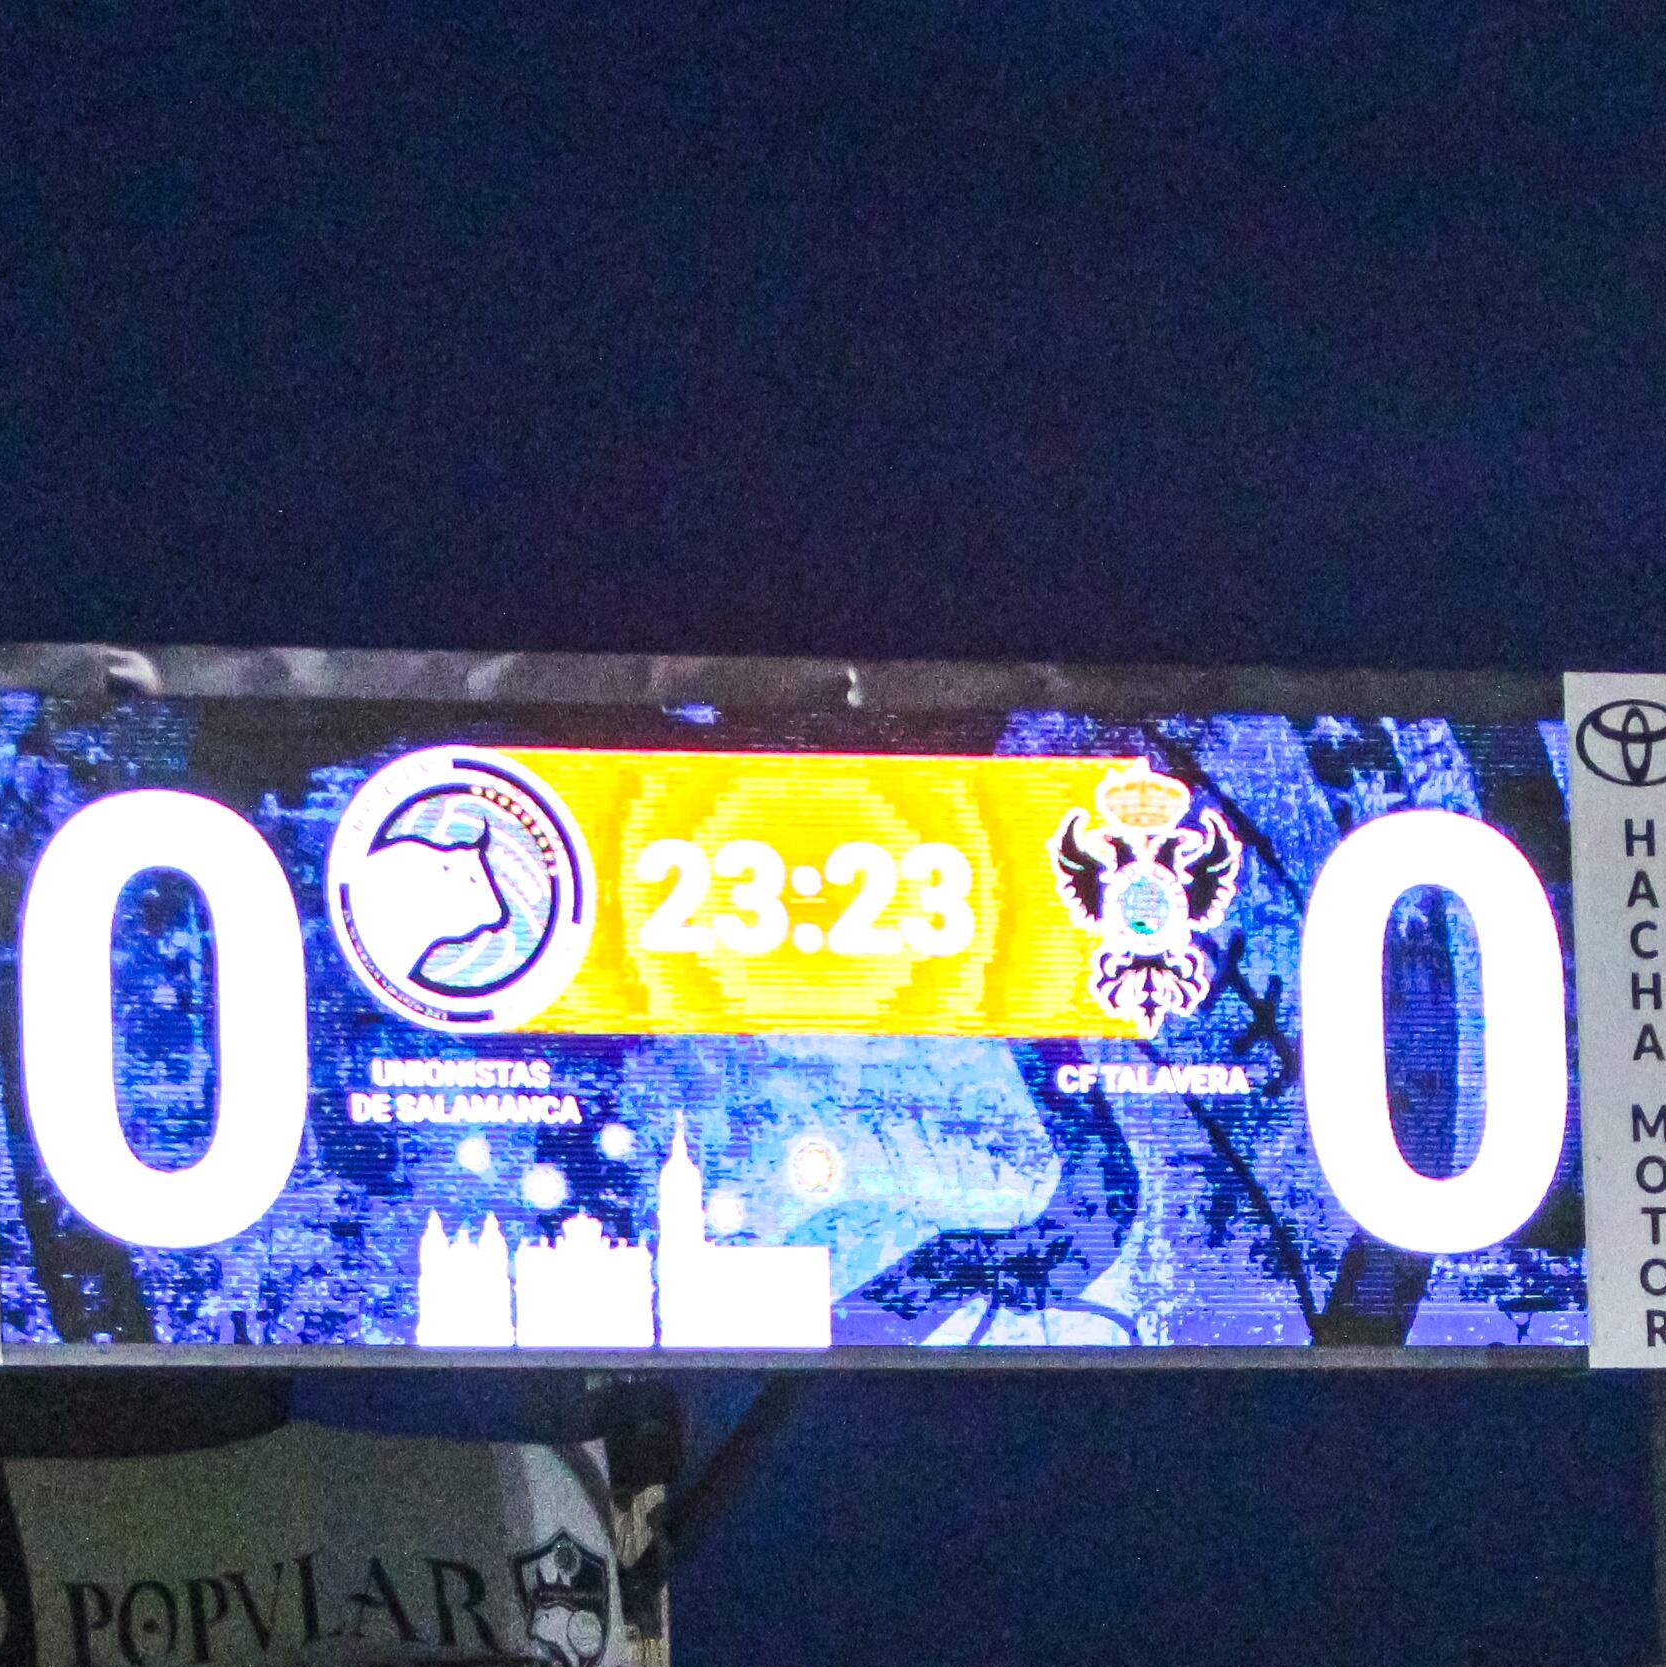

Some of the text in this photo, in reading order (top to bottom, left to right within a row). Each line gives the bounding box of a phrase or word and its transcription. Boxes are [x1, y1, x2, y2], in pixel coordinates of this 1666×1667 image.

[635, 839, 975, 957] 23:23
[19, 789, 308, 1249] 0
[1301, 809, 1567, 1254] 0
[350, 1093, 583, 1125] DE SALAMANCA
[370, 1058, 553, 1089] UNIONISTAS
[1056, 1065, 1250, 1096] CF TALAVERA
